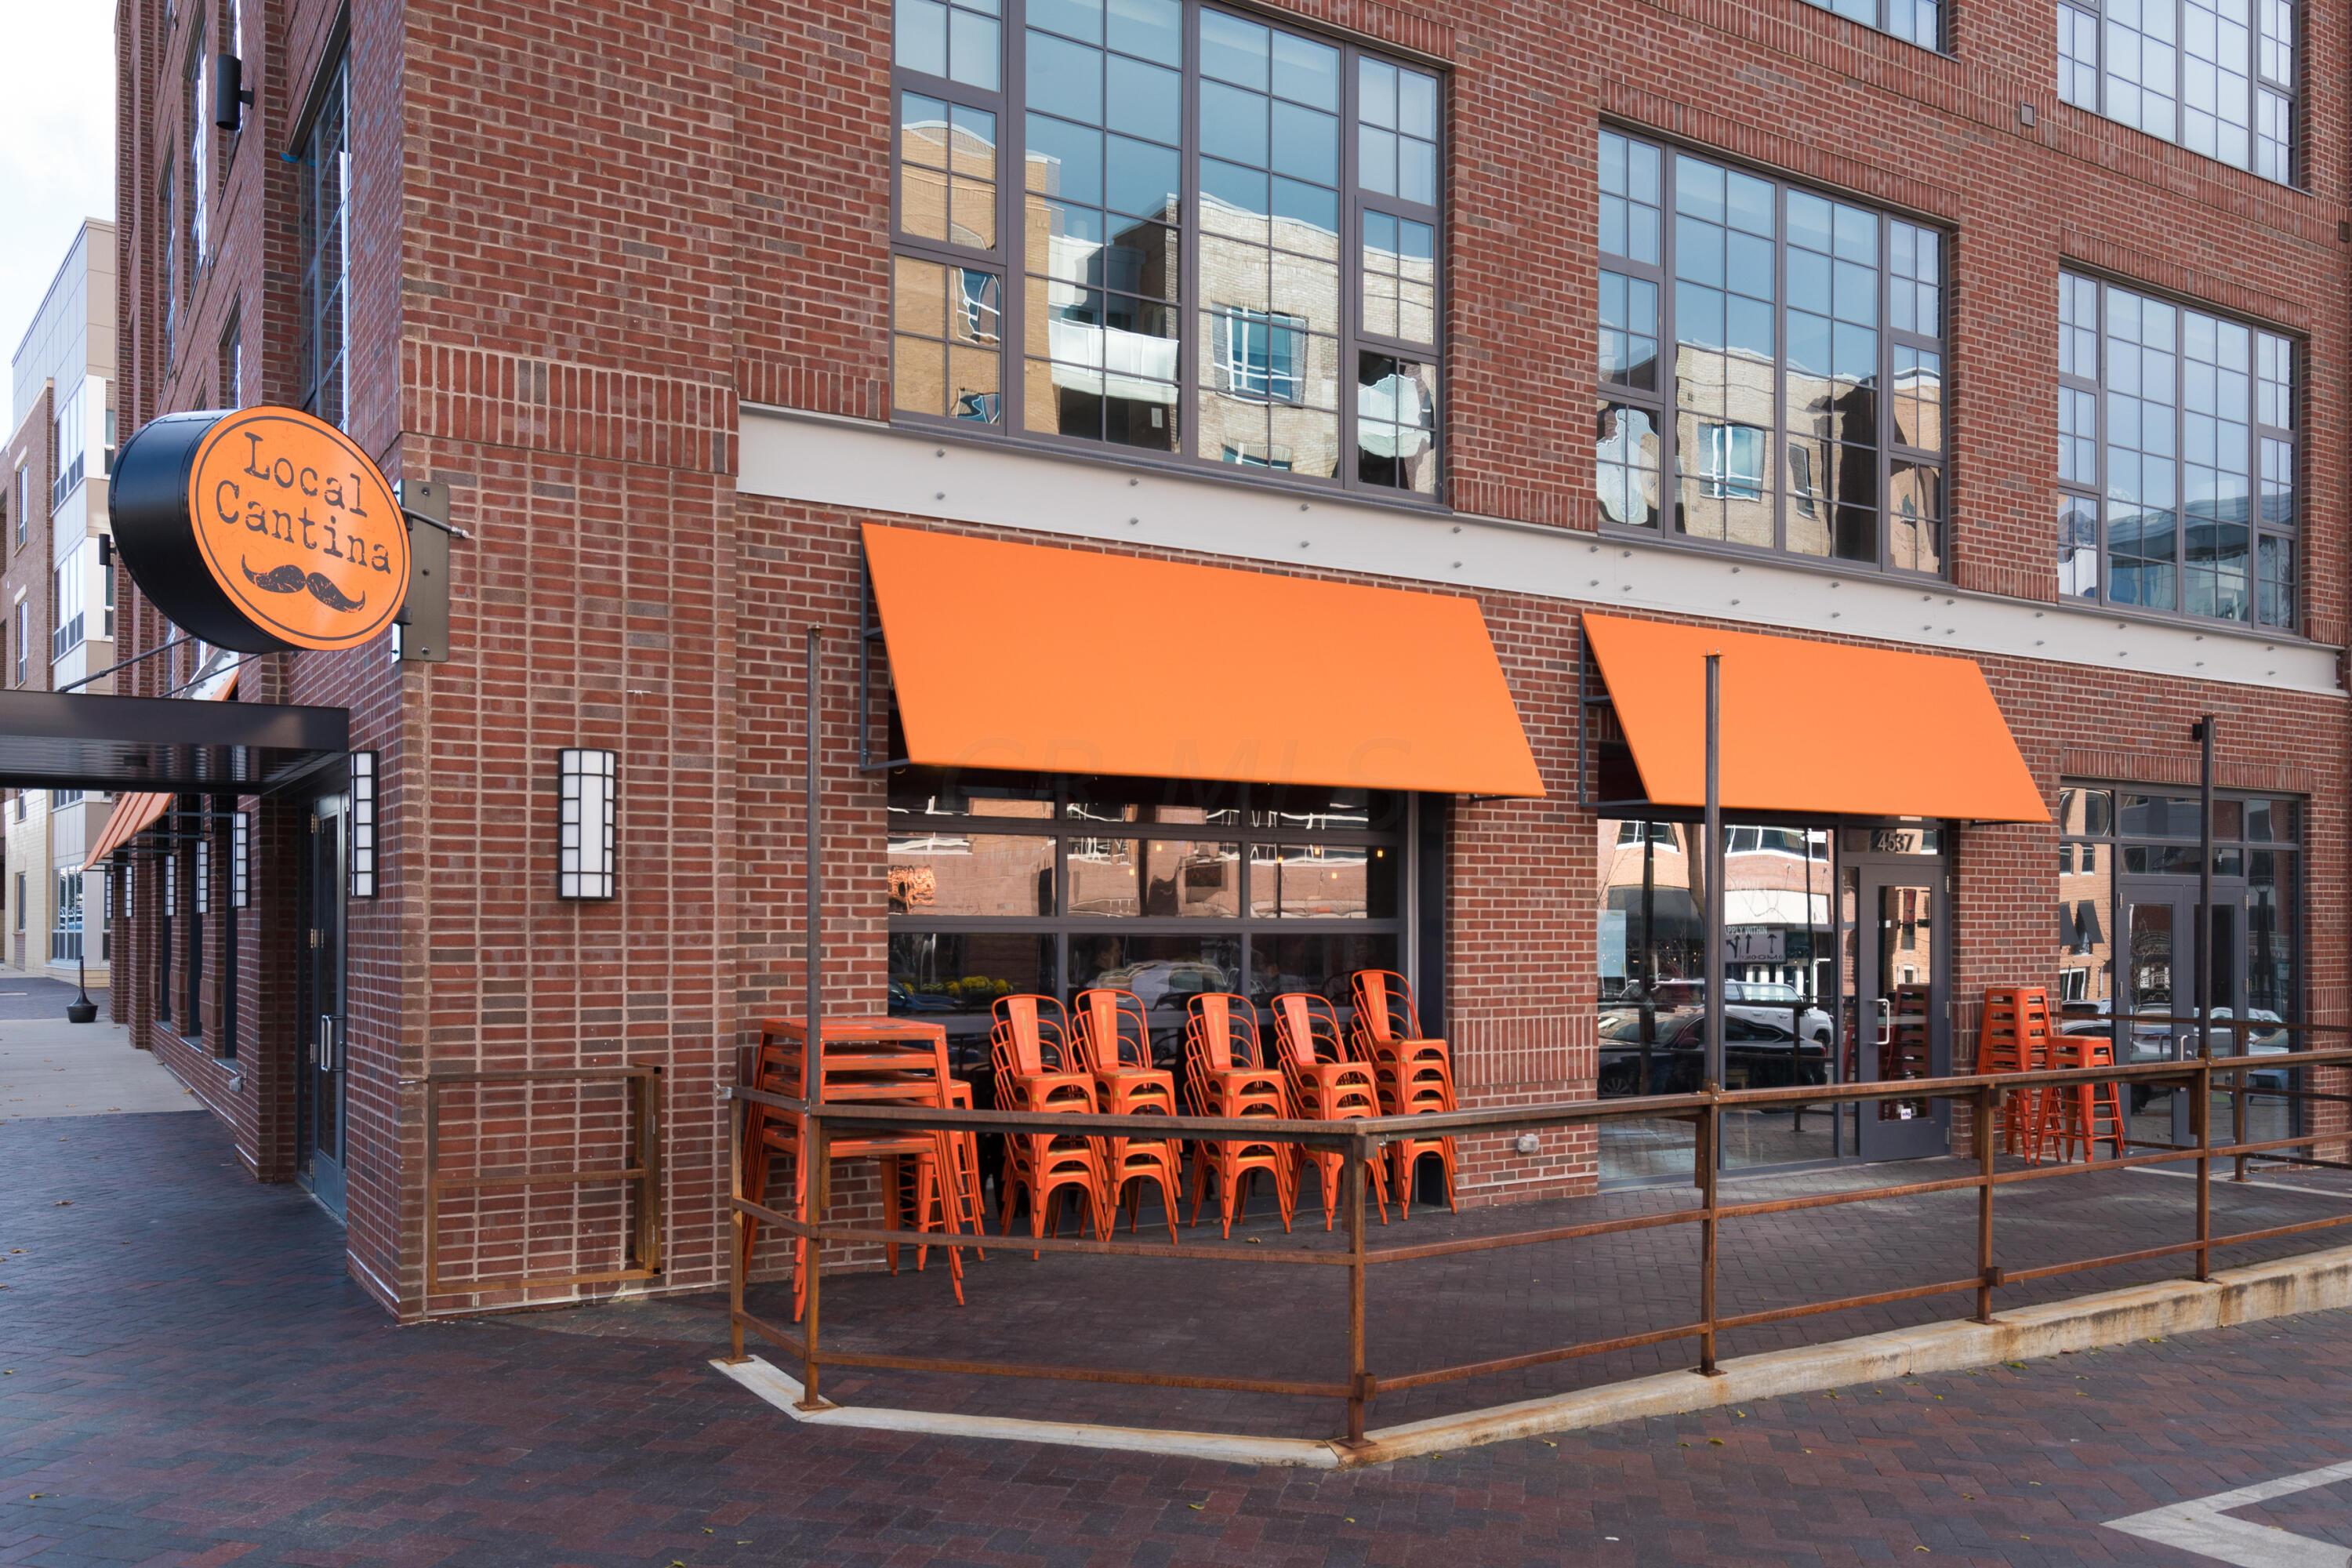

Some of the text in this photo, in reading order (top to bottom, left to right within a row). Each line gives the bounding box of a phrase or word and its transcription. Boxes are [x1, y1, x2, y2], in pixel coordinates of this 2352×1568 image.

[244, 432, 368, 517] Local
[216, 480, 391, 574] Cantina
[1878, 833, 1915, 852] 4537
[1744, 925, 1768, 935] WITHIN
